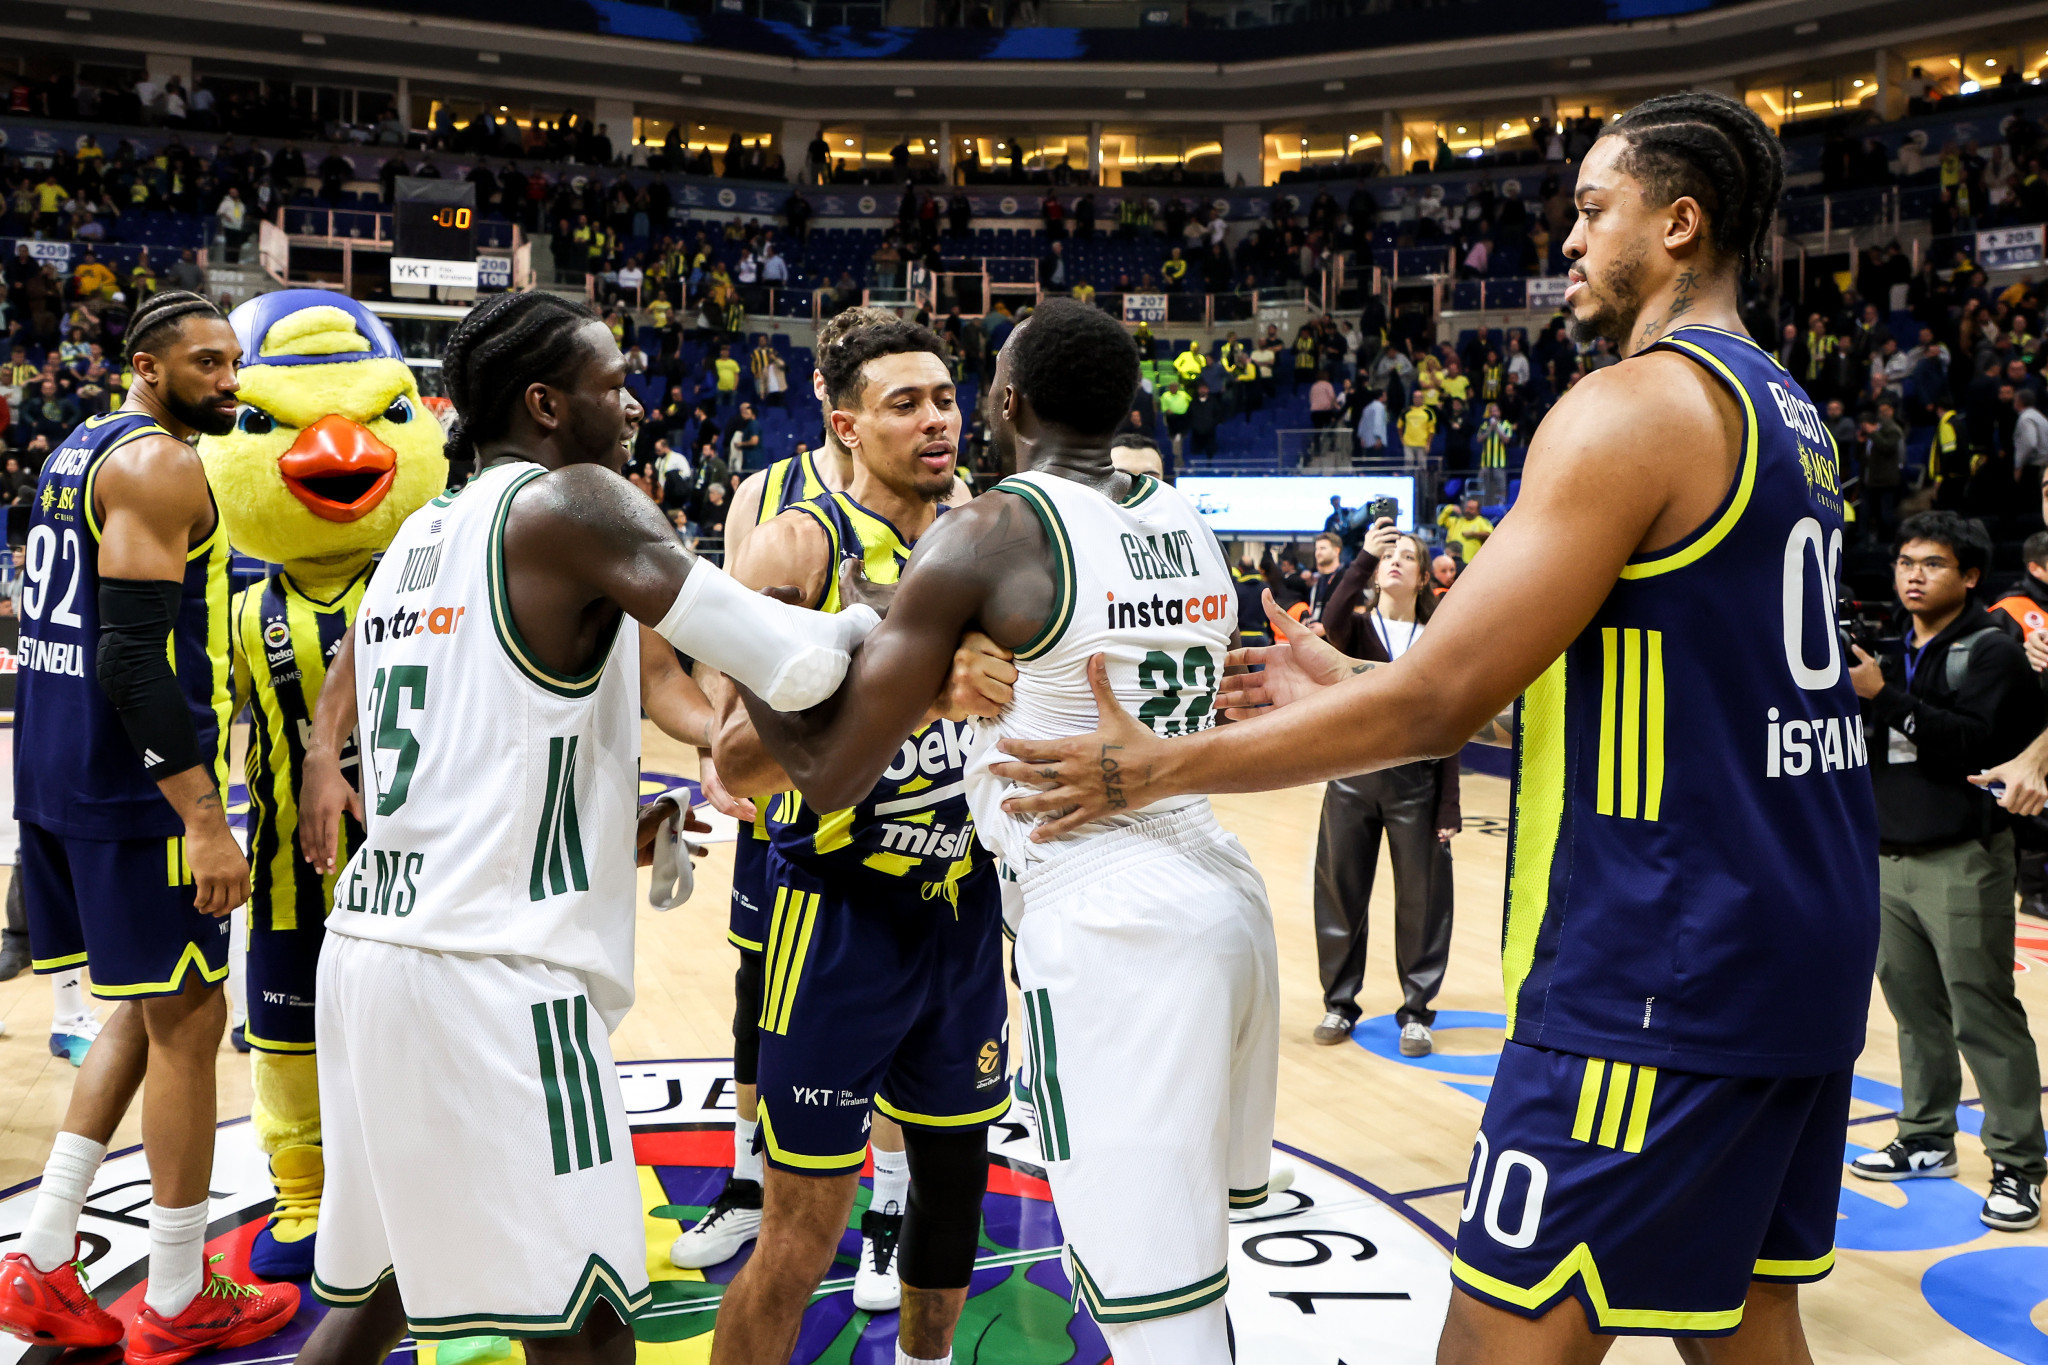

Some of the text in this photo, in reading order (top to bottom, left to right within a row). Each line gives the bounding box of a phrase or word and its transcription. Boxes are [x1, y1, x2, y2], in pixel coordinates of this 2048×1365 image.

[36, 244, 68, 257] 209
[397, 265, 430, 277] YKT
[480, 273, 509, 286] 108
[1140, 296, 1164, 306] 207
[1139, 310, 1165, 320] 107
[1120, 529, 1200, 580] GRANT
[23, 524, 82, 628] 92
[1107, 590, 1228, 629] instacar
[267, 648, 294, 663] beko
[273, 669, 303, 686] RAMS
[1138, 645, 1216, 738] 22
[880, 823, 974, 859] misli
[340, 847, 424, 918] ENS
[262, 990, 286, 1005] YKT
[792, 1085, 834, 1107] YKT
[841, 1090, 853, 1098] Filo
